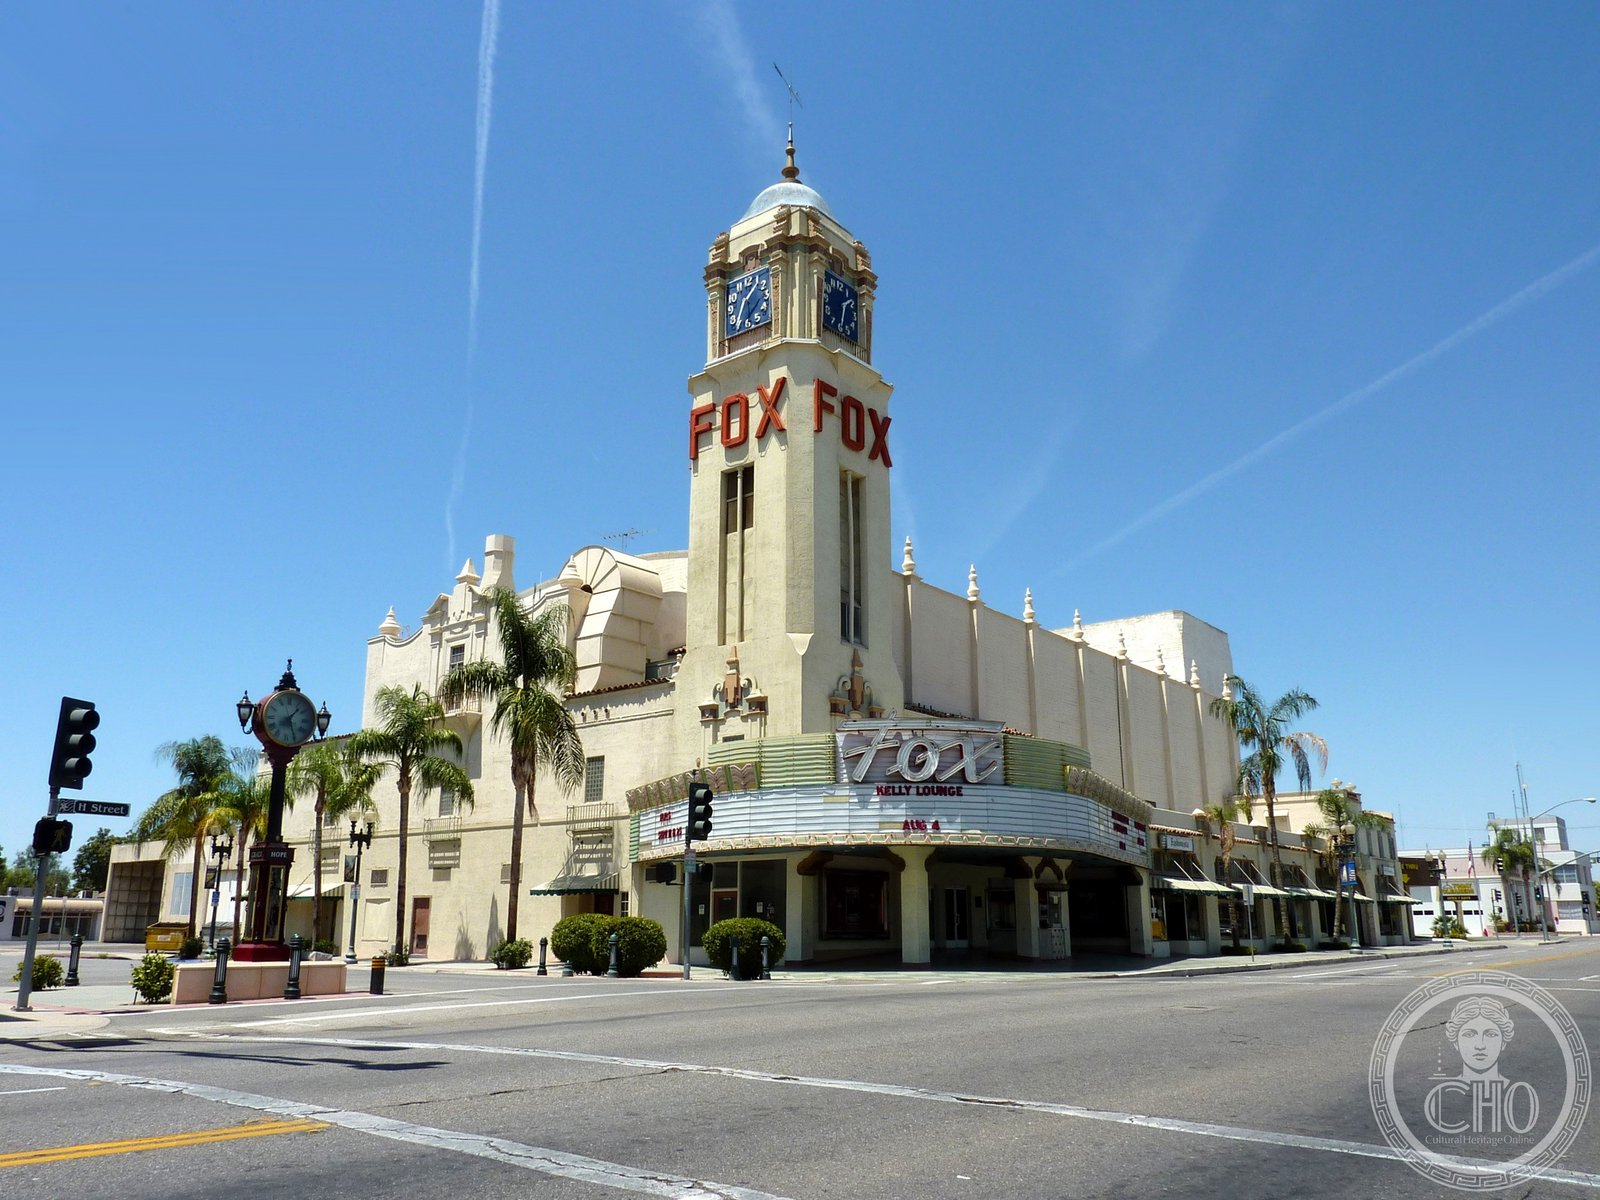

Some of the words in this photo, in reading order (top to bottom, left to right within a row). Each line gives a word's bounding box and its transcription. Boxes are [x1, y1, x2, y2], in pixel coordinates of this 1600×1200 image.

[736, 282, 743, 292] 11
[744, 276, 753, 287] 12
[761, 280, 767, 290] 2
[836, 280, 844, 292] 12
[728, 293, 737, 304] 10
[764, 289, 770, 300] 3
[728, 305, 734, 315] 9
[760, 302, 767, 311] 4
[730, 315, 736, 325] 8
[754, 313, 760, 322] 5
[831, 316, 836, 325] 7
[744, 319, 751, 328] 6
[689, 376, 787, 460] FOX
[813, 378, 892, 468] FOX
[876, 785, 912, 796] KELLY
[915, 785, 964, 796] LOUNGE
[78, 803, 87, 812] H
[90, 803, 125, 814] Street
[902, 820, 927, 831] AUG
